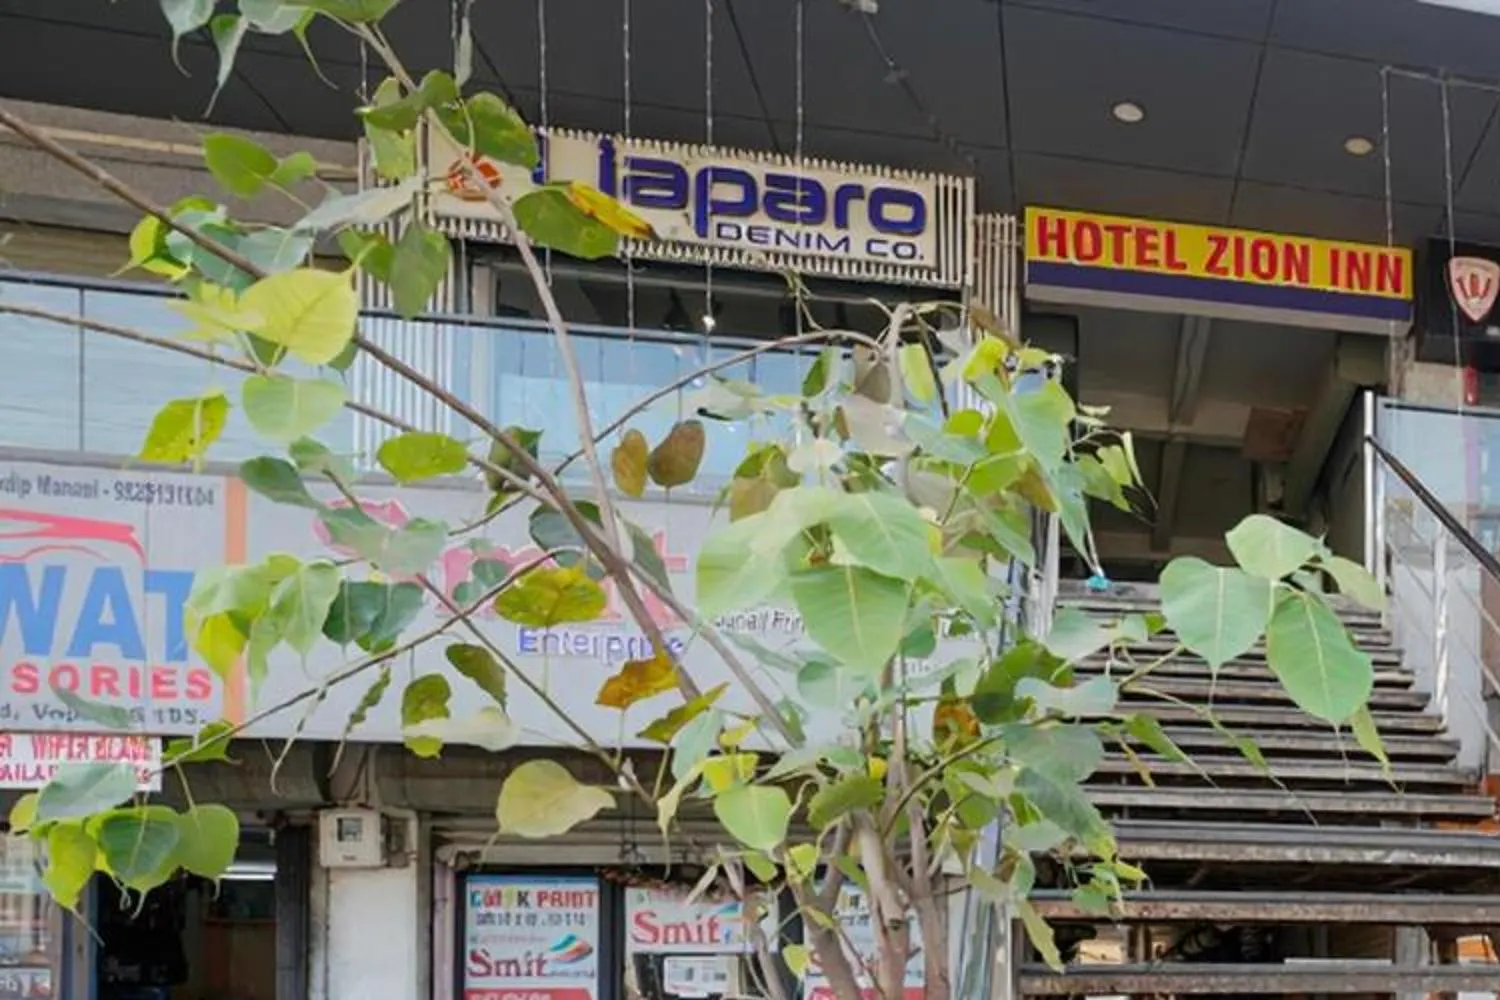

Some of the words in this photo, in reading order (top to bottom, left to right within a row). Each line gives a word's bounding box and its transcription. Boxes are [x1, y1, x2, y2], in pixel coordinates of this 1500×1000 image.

[714, 221, 850, 254] DENIM
[864, 236, 925, 261] CO.
[1036, 214, 1187, 271] HOTEL
[1204, 234, 1310, 285] ZION
[1329, 248, 1404, 294] INN
[517, 626, 684, 668] Enterprie
[11, 661, 213, 701] SORIES
[631, 910, 722, 945] Smit
[468, 948, 548, 978] Smit
